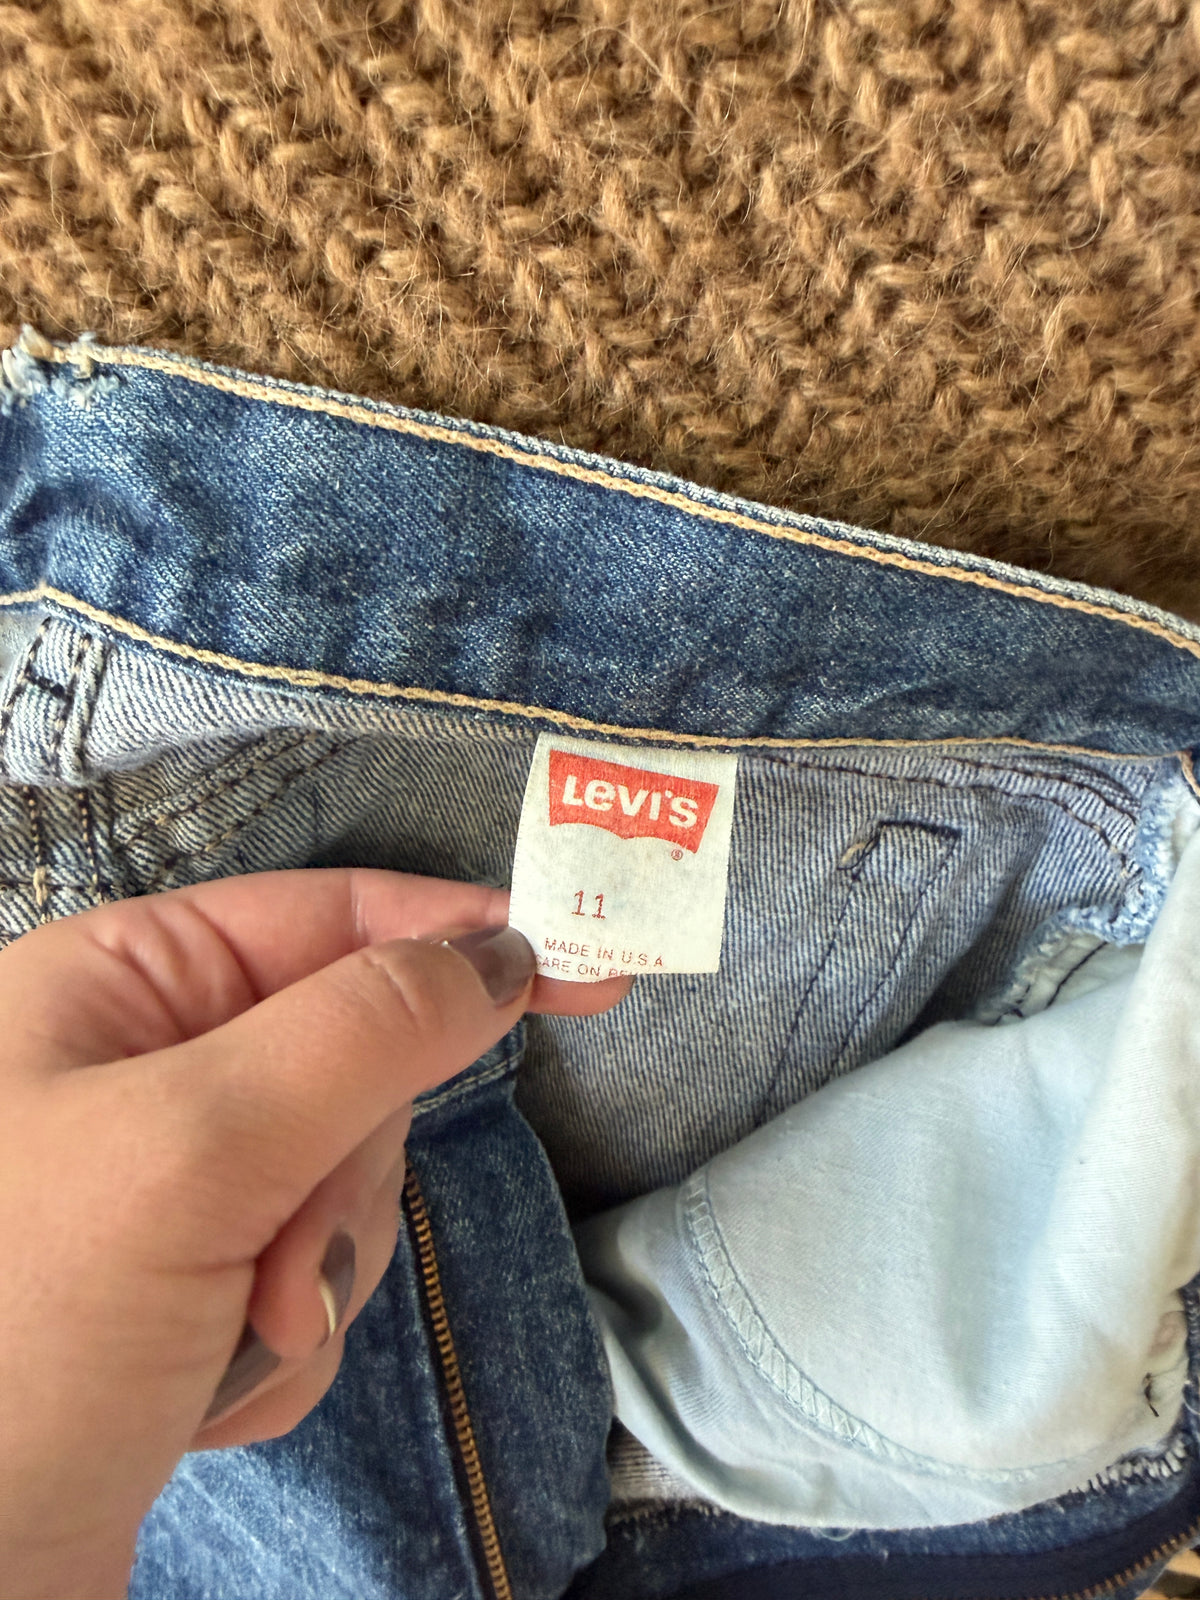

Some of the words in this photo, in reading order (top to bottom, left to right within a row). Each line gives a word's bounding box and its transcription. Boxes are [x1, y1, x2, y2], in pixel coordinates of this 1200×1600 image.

[571, 889, 607, 920] 11
[545, 937, 591, 957] MADE
[597, 946, 614, 960] IN
[577, 963, 602, 977] ON
